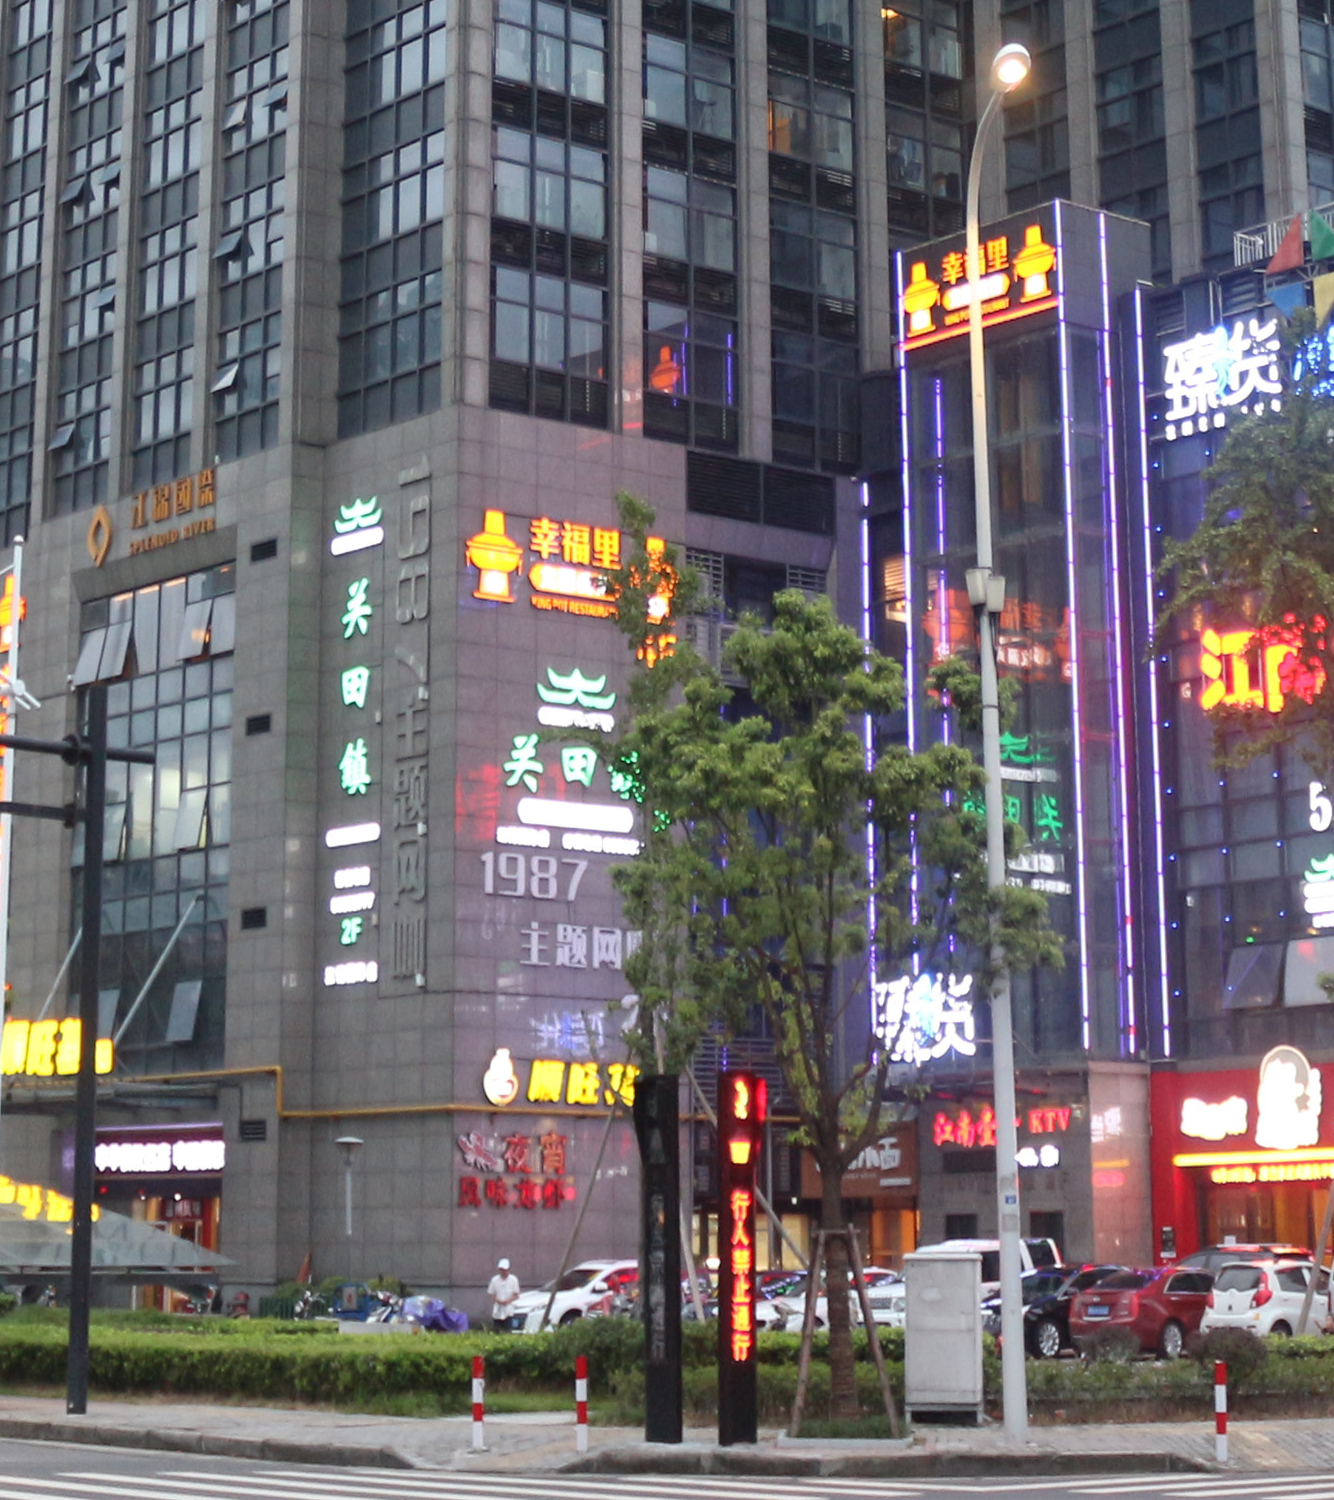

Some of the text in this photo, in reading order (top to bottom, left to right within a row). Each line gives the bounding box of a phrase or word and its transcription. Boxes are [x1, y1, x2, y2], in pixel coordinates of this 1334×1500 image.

[529, 516, 622, 571] 幸福里
[480, 851, 589, 902] 1987
[340, 915, 363, 946] 2F
[933, 1104, 1072, 1149] 江南壹 KTV
